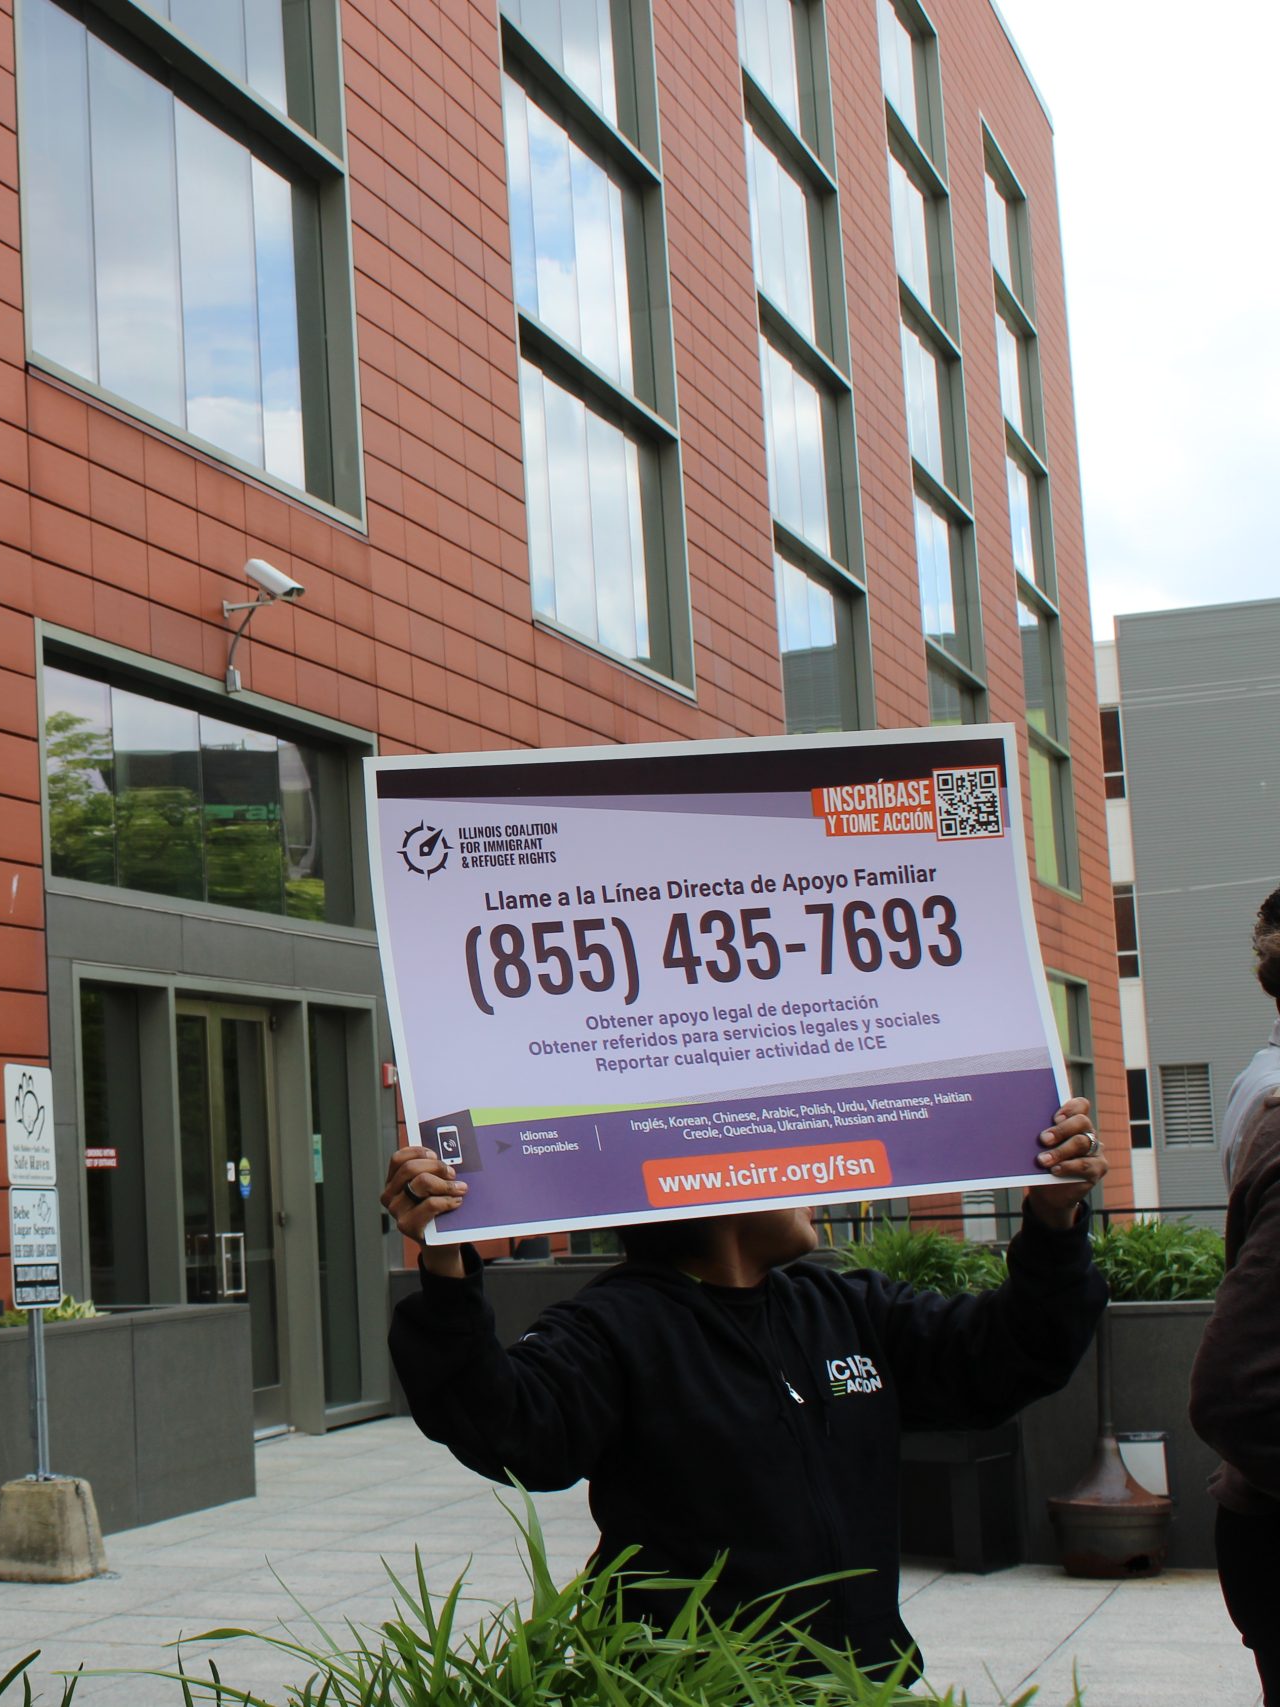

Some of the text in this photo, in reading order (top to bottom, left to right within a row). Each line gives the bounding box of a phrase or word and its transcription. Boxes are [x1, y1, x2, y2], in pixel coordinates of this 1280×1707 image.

[822, 778, 932, 813] INSCRÍBASE
[458, 822, 558, 840] ILLINOIS COALITION
[827, 807, 934, 834] Y TOME ACCIÓN
[460, 837, 543, 854] FOR IMMIGRANT
[461, 851, 557, 869] & REFUGEE RIGHTS
[485, 864, 937, 911] Llame a la Línea Directa de Apoyo Familiar
[465, 894, 963, 1016] (855) 435-7693
[585, 995, 879, 1030] Obtener apoyo legal de deportación
[528, 1011, 940, 1056] Obtener referidos para servicios legales y sociales
[595, 1035, 887, 1074] Reportar cualquier actividad de ICE
[630, 1091, 972, 1133] Inglés, Korean, Chinese, Arabic, Polish, Urdu, Vietnamese, Haitian
[683, 1107, 929, 1140] Creole, Quechua, Ukrainian, Russian and Hindi
[519, 1130, 559, 1141] Idiomas
[522, 1140, 580, 1156] Disponibles
[14, 1154, 50, 1171] Safe Haven
[658, 1154, 876, 1193] www.icirr.org/fsn
